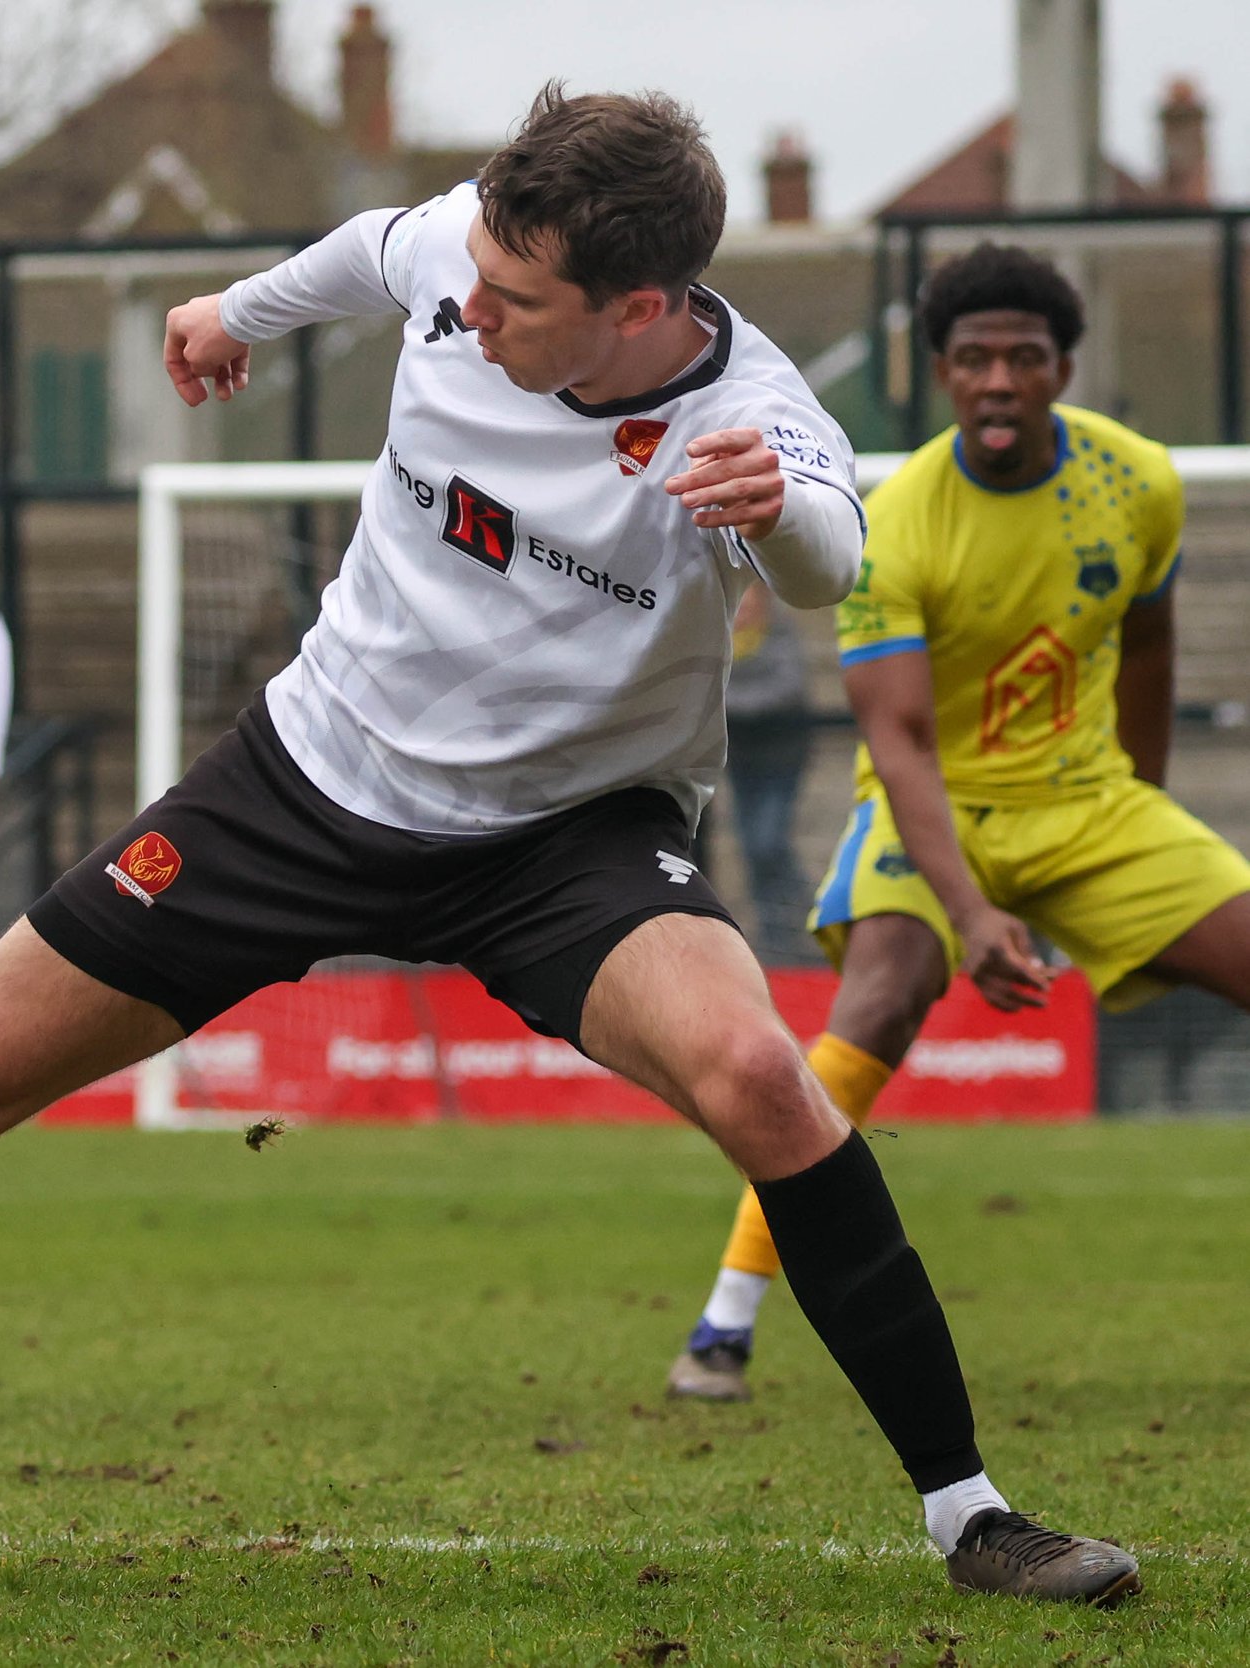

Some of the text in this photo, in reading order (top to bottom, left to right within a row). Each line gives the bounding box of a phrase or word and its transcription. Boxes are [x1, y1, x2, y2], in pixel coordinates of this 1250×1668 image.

[450, 488, 507, 562] K
[528, 535, 657, 611] Estates
[109, 866, 150, 902] BALHAM FC
